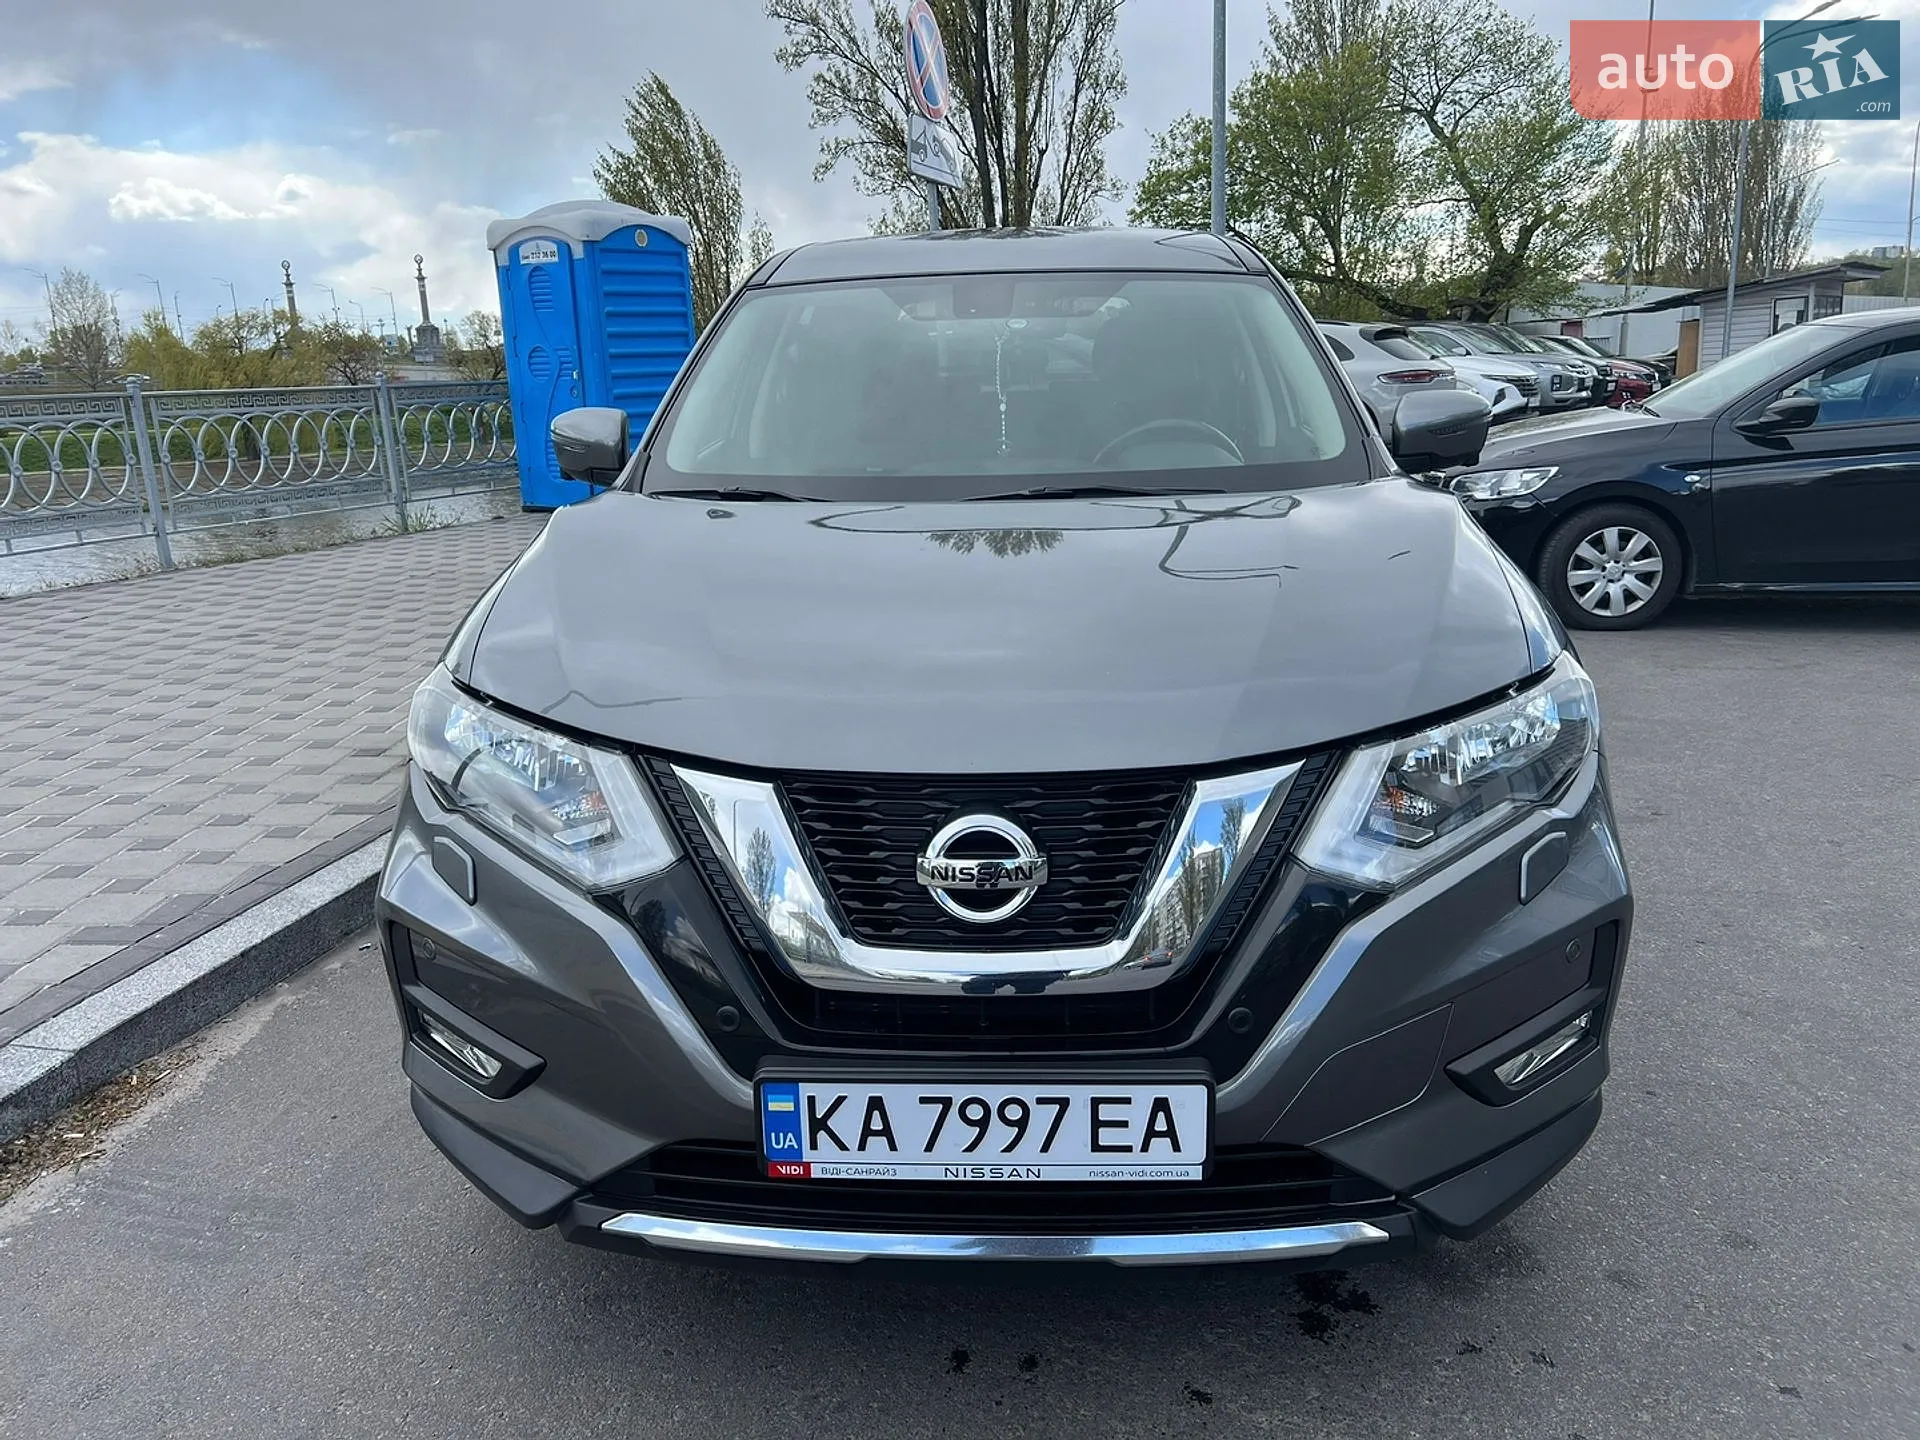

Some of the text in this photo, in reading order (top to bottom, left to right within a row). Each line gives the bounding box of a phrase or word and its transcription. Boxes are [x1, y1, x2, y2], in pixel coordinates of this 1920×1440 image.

[930, 865, 1033, 882] NISSAN
[806, 1095, 1182, 1153] KA 7997 EA
[771, 1132, 798, 1150] UA
[776, 1165, 804, 1175] VIDI
[944, 1167, 1042, 1179] NISSAN
